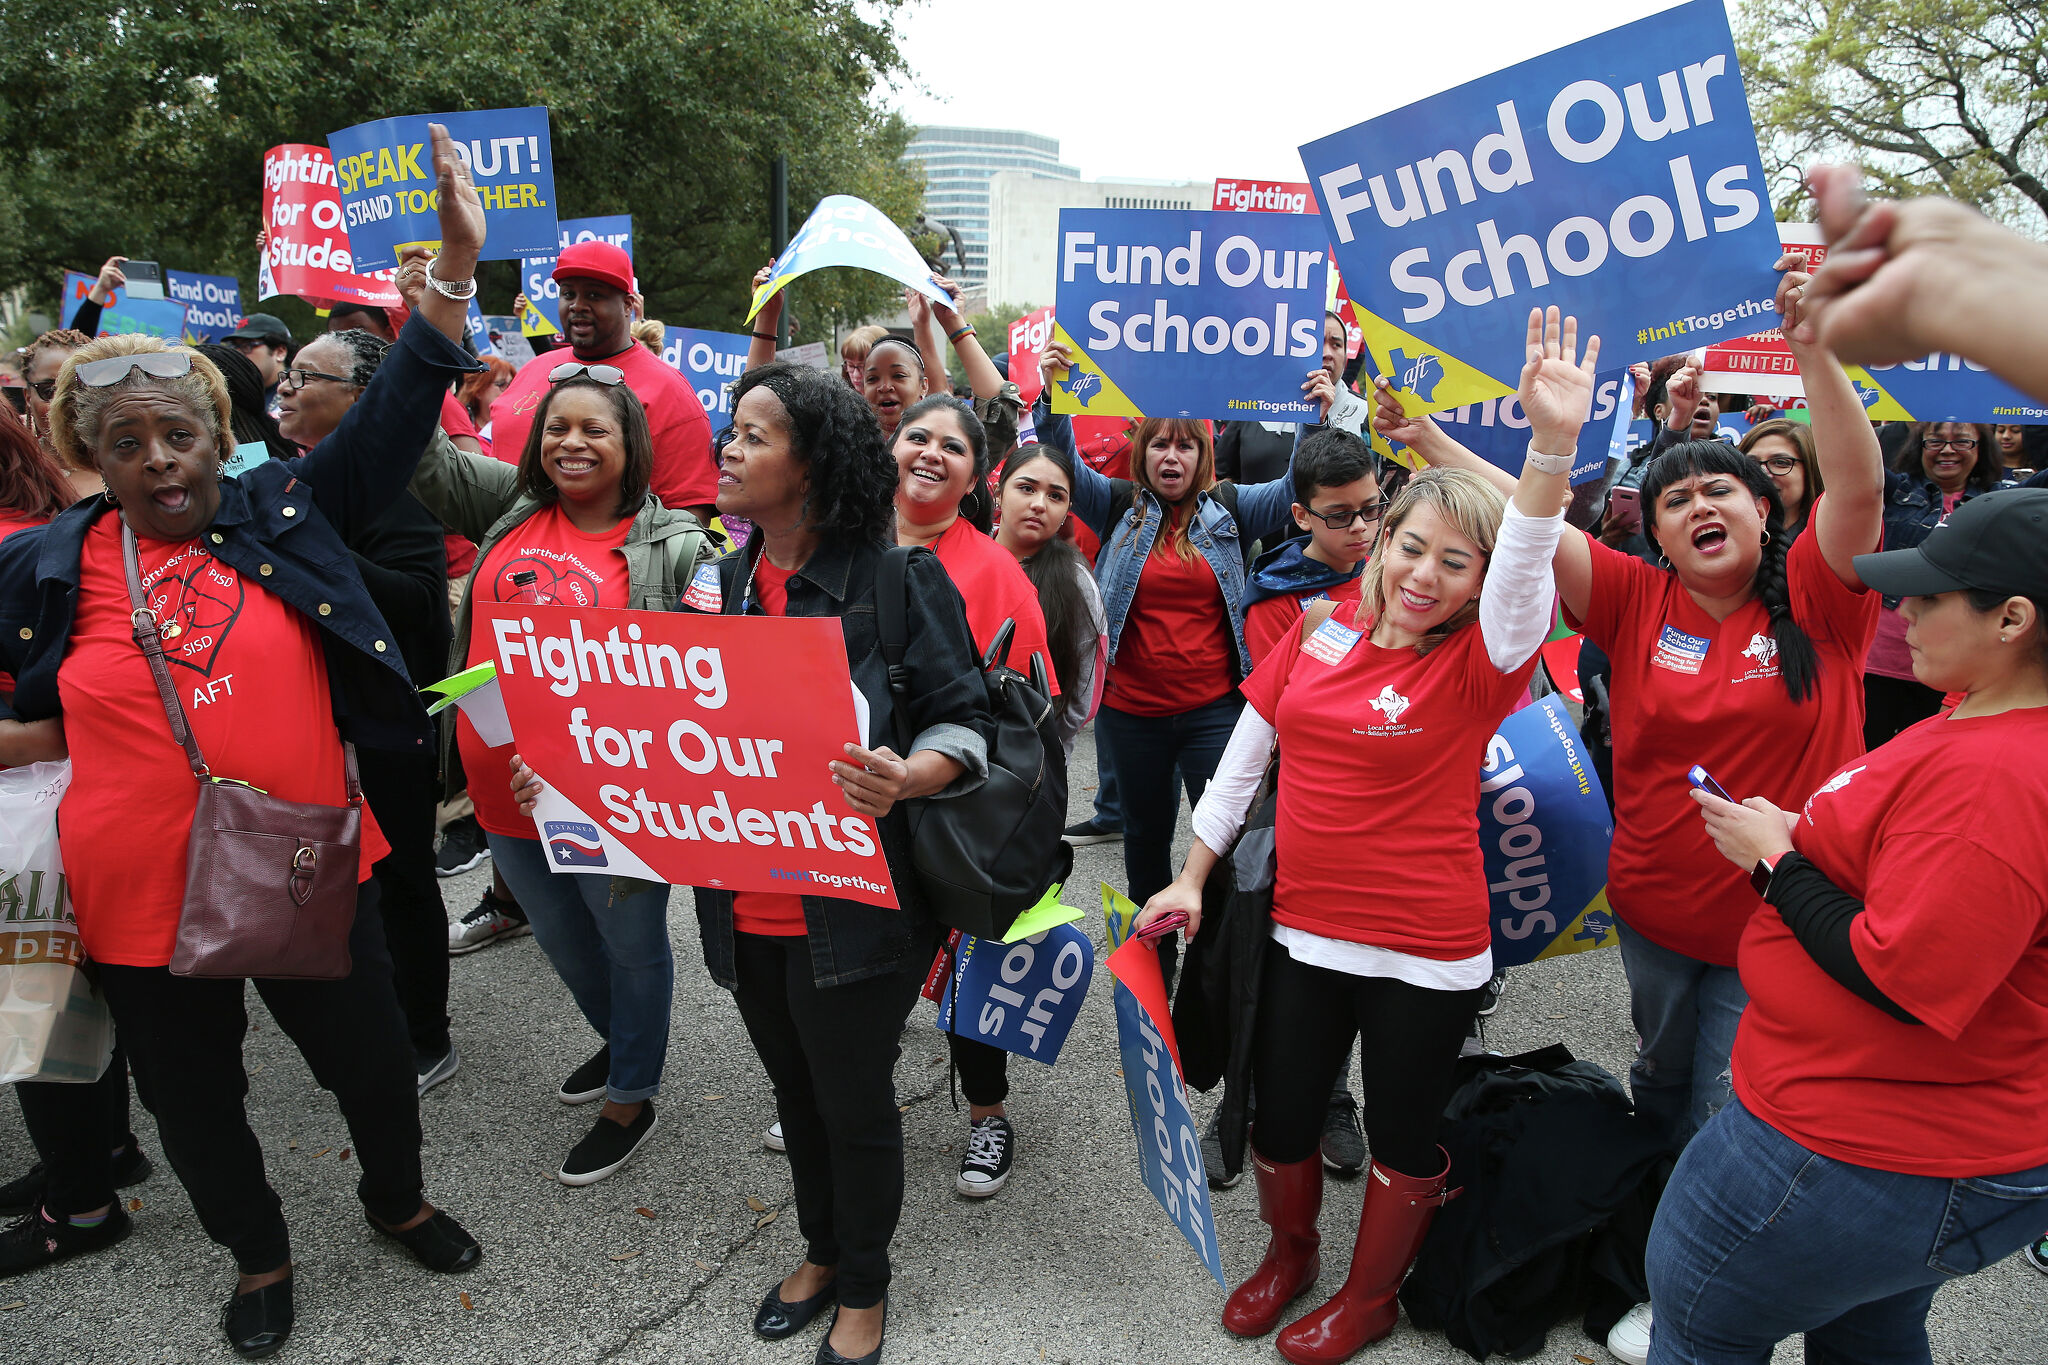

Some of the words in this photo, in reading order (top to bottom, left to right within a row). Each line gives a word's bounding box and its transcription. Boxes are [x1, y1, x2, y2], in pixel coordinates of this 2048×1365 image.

[337, 143, 429, 195] SPEAK
[1318, 99, 1535, 246] Fund
[1547, 54, 1727, 164] Our
[264, 150, 339, 193] Fightin
[272, 195, 307, 228] for
[346, 194, 393, 228] STAND
[395, 183, 547, 216] TOHER.
[1215, 183, 1307, 214] Fighting
[1389, 154, 1761, 325] Schools
[270, 236, 397, 284] Stude
[1063, 230, 1202, 287] Fund
[1215, 234, 1324, 290] Our
[168, 277, 204, 302] Fund
[204, 282, 238, 305] Our
[187, 307, 242, 329] chools
[1010, 310, 1056, 357] Figh
[1087, 299, 1318, 358] Schools
[1636, 296, 1776, 345] #InItTogethe
[687, 342, 749, 377] Our
[1402, 352, 1440, 395] aft
[1728, 354, 1796, 372] UNITED
[1071, 371, 1103, 399] aft
[1227, 399, 1316, 414] #InItTogether
[1567, 459, 1604, 480] ogether
[566, 553, 604, 584] Houston
[569, 581, 589, 607] GPISD
[183, 635, 213, 657] SISD
[1325, 619, 1347, 635] Fund
[1666, 626, 1687, 642] Fund
[1687, 637, 1706, 646] Our
[1666, 634, 1701, 652] Schools
[491, 616, 729, 710] Fighting
[1653, 655, 1667, 665] Our
[1666, 660, 1698, 672] Students
[1657, 650, 1686, 665] Fighting
[193, 673, 234, 710] AFT
[568, 706, 654, 769] for
[667, 719, 784, 779] Our
[1541, 703, 1591, 796] #InItTogether
[599, 783, 877, 858] Students
[1480, 733, 1557, 941] Schools
[769, 867, 889, 896] #InItTogether
[1020, 940, 1084, 1054] Our
[1136, 999, 1184, 1223] hools
[1179, 1124, 1210, 1265] Our
